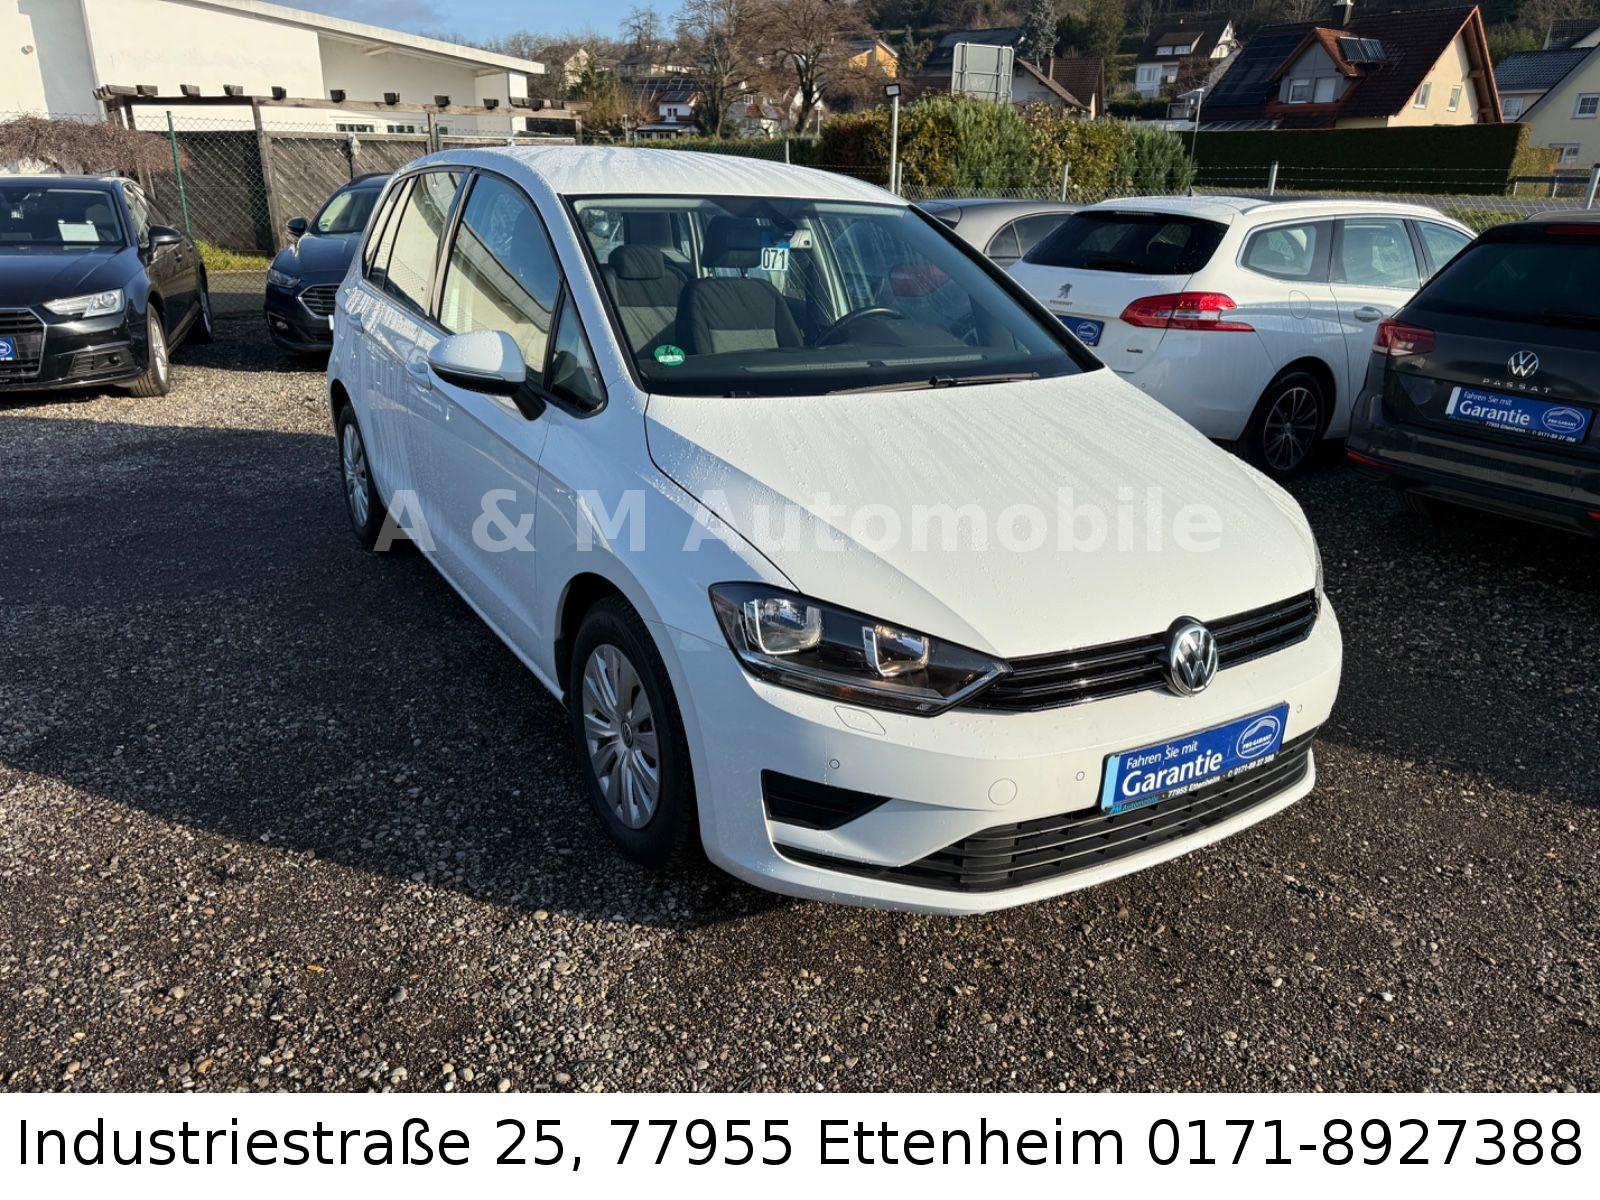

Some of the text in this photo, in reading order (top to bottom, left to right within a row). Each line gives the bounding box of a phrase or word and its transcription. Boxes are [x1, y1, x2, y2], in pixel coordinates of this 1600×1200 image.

[763, 248, 785, 269] 071
[1482, 377, 1552, 394] PASSAT
[1463, 391, 1487, 402] Fahren
[1488, 395, 1499, 404] Sie
[1459, 400, 1531, 426] Garantie
[1126, 740, 1199, 770] Fahren Sie mit
[1122, 749, 1223, 797] Garantie
